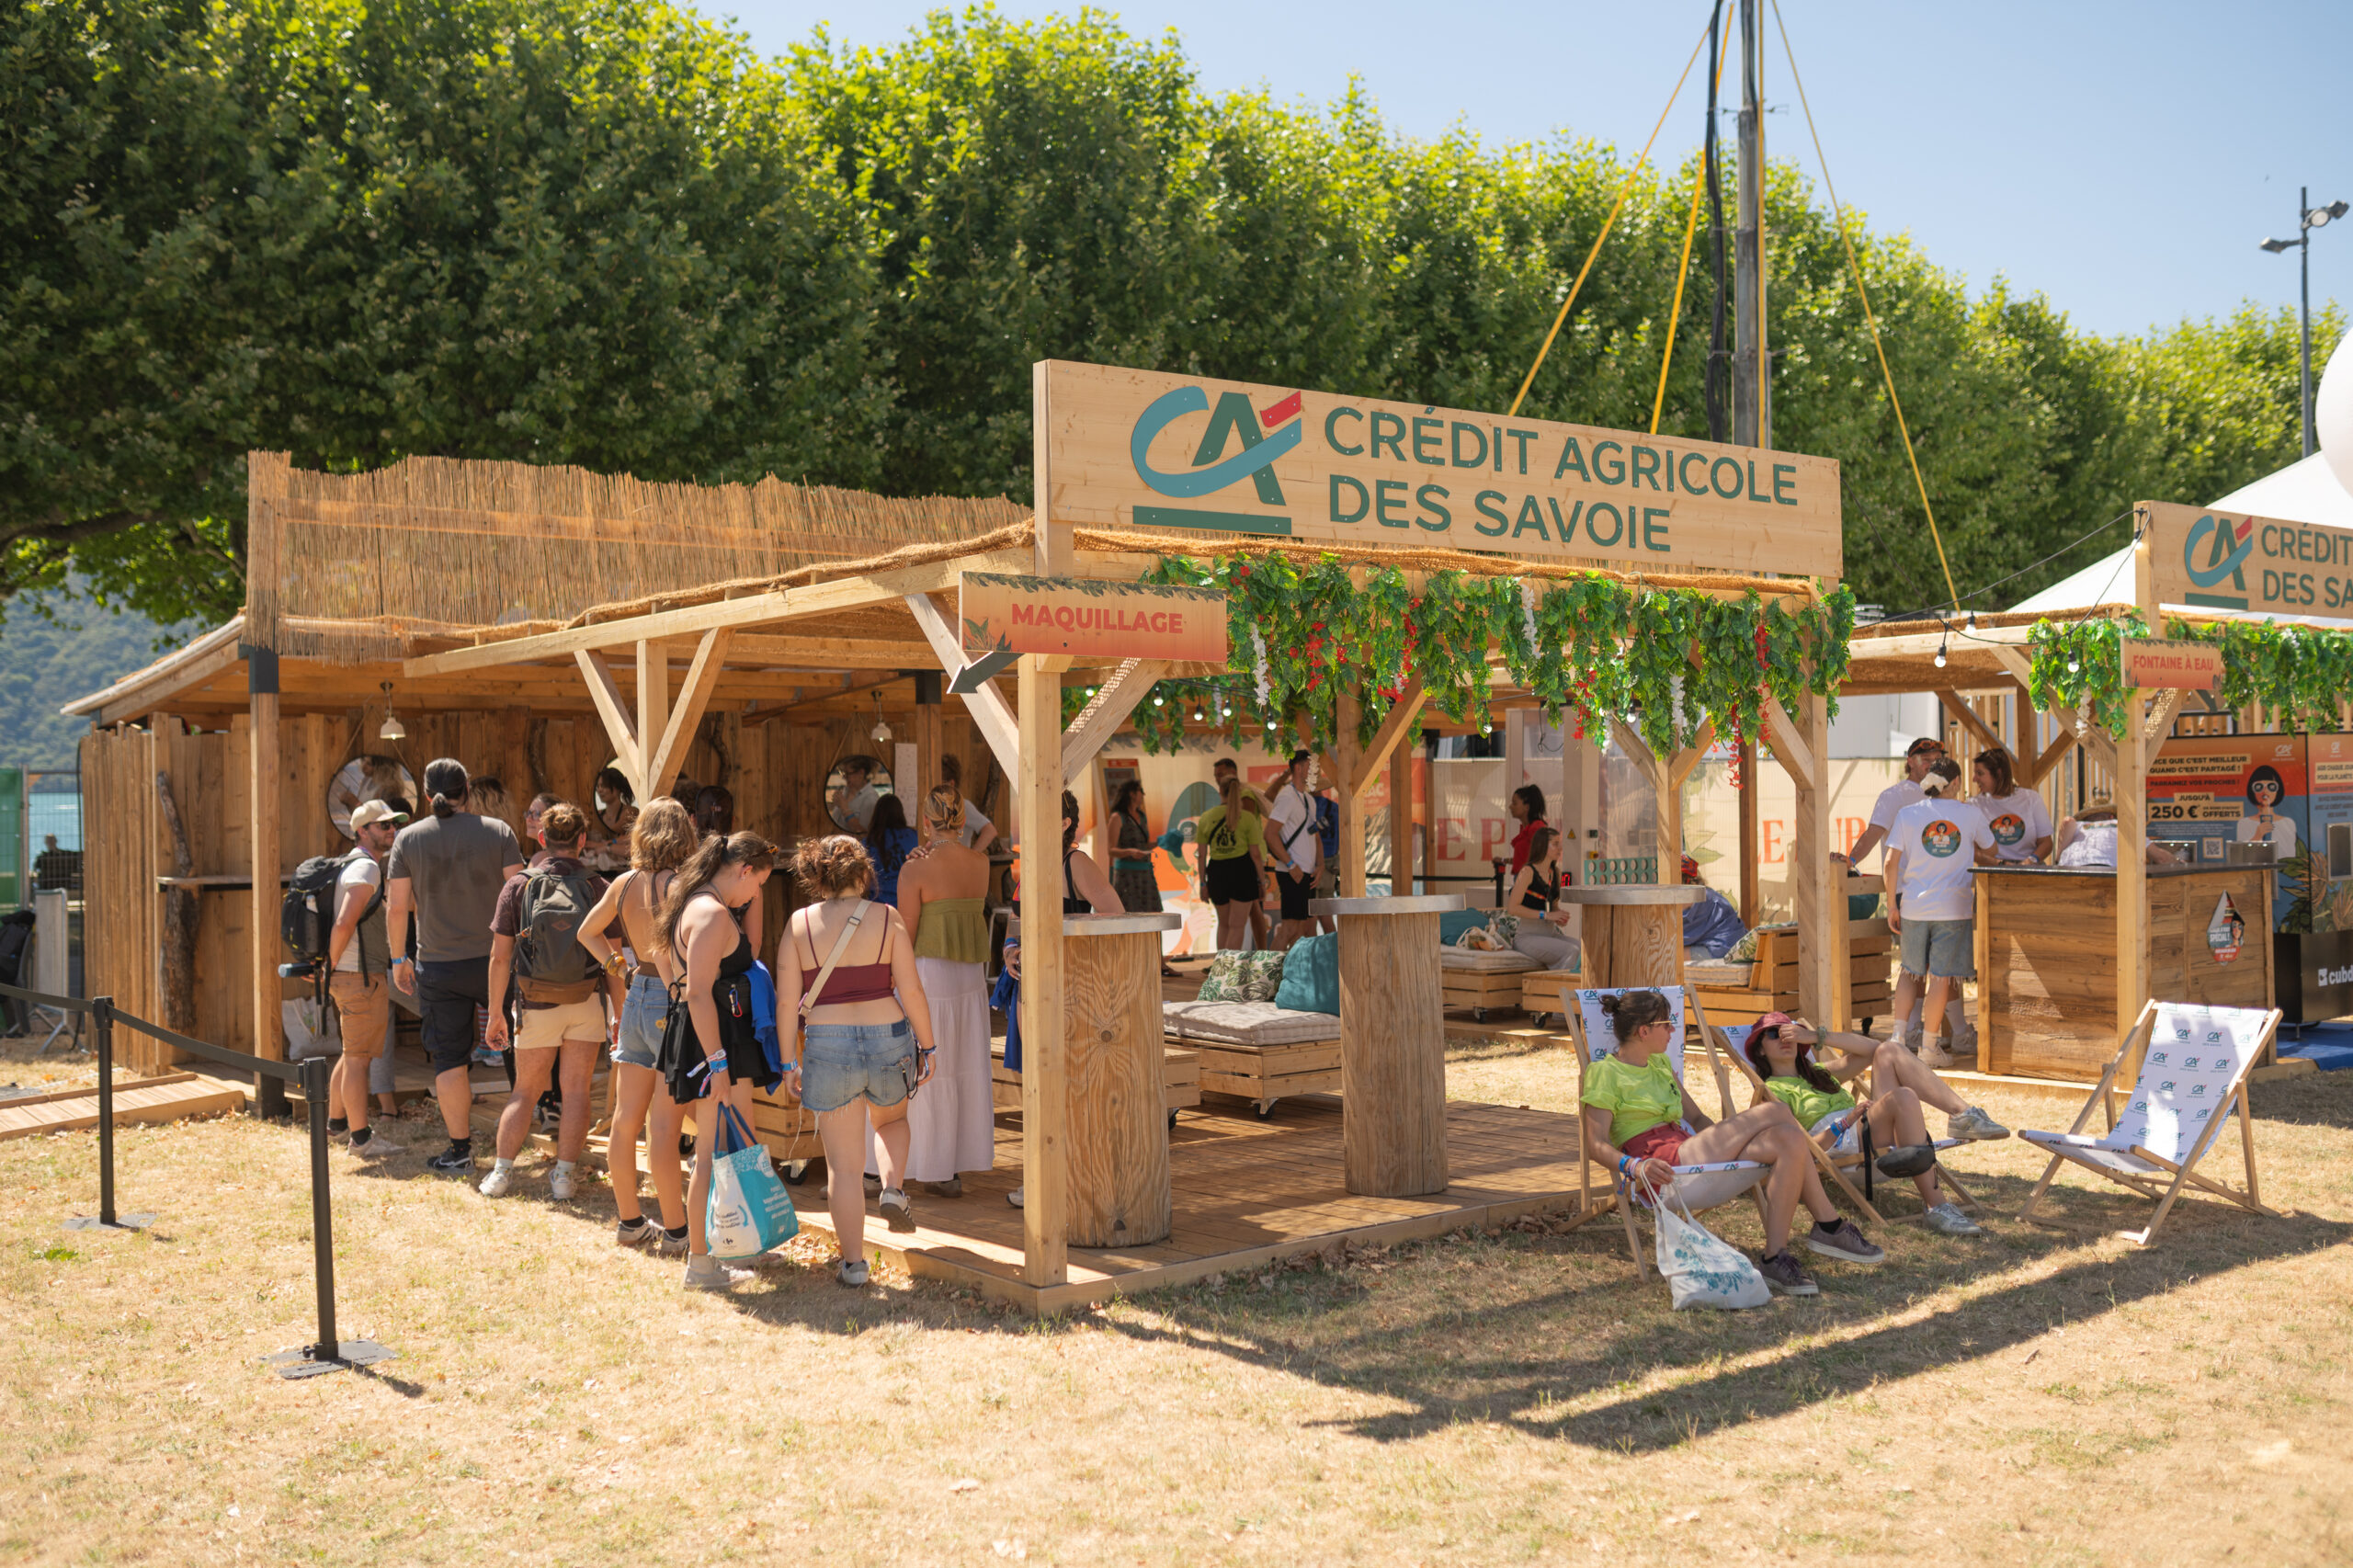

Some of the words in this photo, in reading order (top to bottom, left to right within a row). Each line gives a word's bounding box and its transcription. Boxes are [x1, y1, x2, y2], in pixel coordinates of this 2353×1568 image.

[1324, 405, 1539, 474] CRÉDIT
[1554, 437, 1798, 506] AGRICOLE
[1329, 474, 1452, 532] DES
[1473, 490, 1671, 551] SAVOIE
[2261, 522, 2353, 566] CRÉDIT
[2263, 569, 2315, 606] DES
[1011, 603, 1183, 633] MAQUILLAGE
[2133, 654, 2183, 670] FONTAINE
[2185, 653, 2192, 670] À
[2195, 657, 2214, 671] EAU
[2152, 805, 2184, 819] 250
